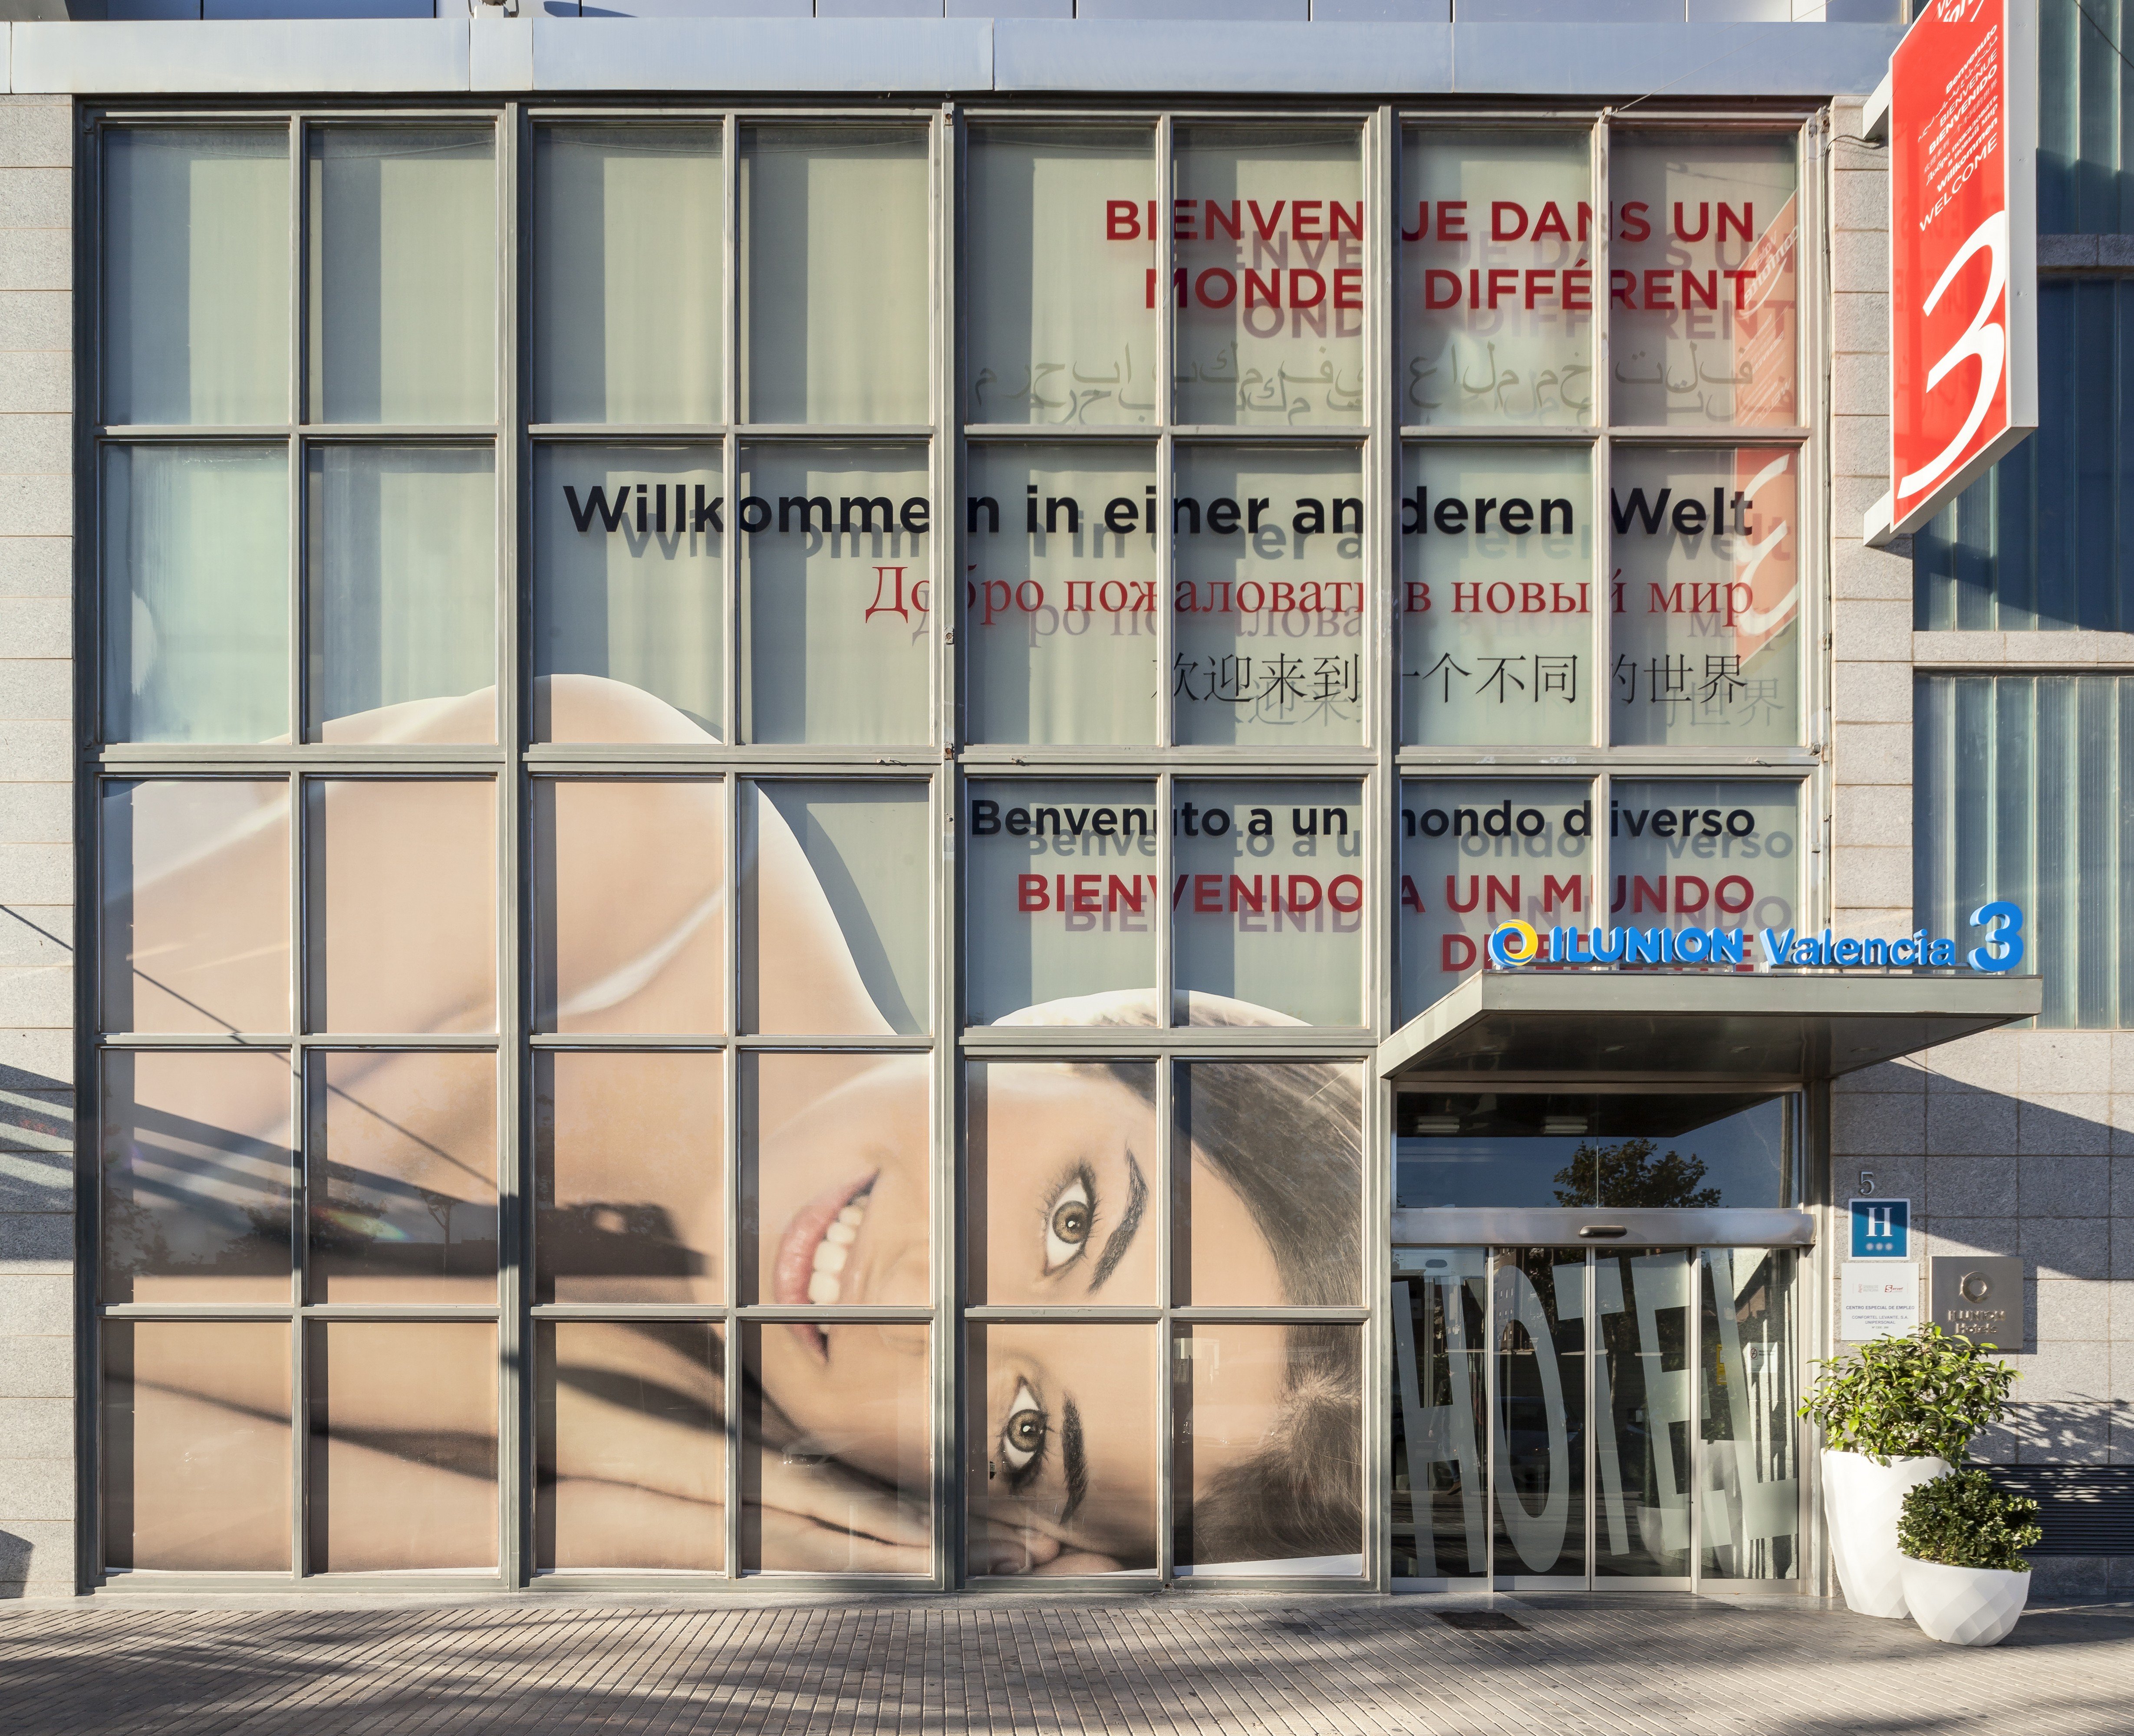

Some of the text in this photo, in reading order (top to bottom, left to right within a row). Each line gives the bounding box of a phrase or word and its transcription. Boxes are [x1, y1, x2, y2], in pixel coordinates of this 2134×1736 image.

[1940, 48, 1997, 127] BIENVENUE
[1946, 24, 1997, 95] Benvenuto
[1929, 64, 1997, 155] BIENVENIDO
[1954, 124, 1979, 160] новый
[1981, 103, 1998, 127] мир
[1927, 95, 1998, 186] Добро пожаловать
[1937, 117, 1998, 192] Willkommen
[1919, 132, 1997, 231] WELCOME
[1674, 201, 1753, 243] UN
[1146, 258, 1757, 310] MONDE DIFFÉRENT
[1897, 210, 2006, 499] 3
[563, 484, 1753, 536] Willkommen in einer anderen Welt
[1404, 582, 1432, 613] в
[1647, 582, 1754, 627] мир
[1248, 807, 1273, 836] a
[1291, 808, 1347, 836] un
[1563, 800, 1755, 837] diverso
[1018, 874, 1363, 913] BIENVENIDO
[1446, 875, 1520, 913] UN
[1548, 926, 1743, 963] ILUNION
[1759, 927, 1956, 967] Valencia
[1967, 901, 2024, 973] 3
[1860, 1171, 1875, 1196] 5
[1866, 1207, 1893, 1236] H
[1948, 1310, 2006, 1322] ILUNION
[1392, 1246, 1798, 1578] HOTEL
